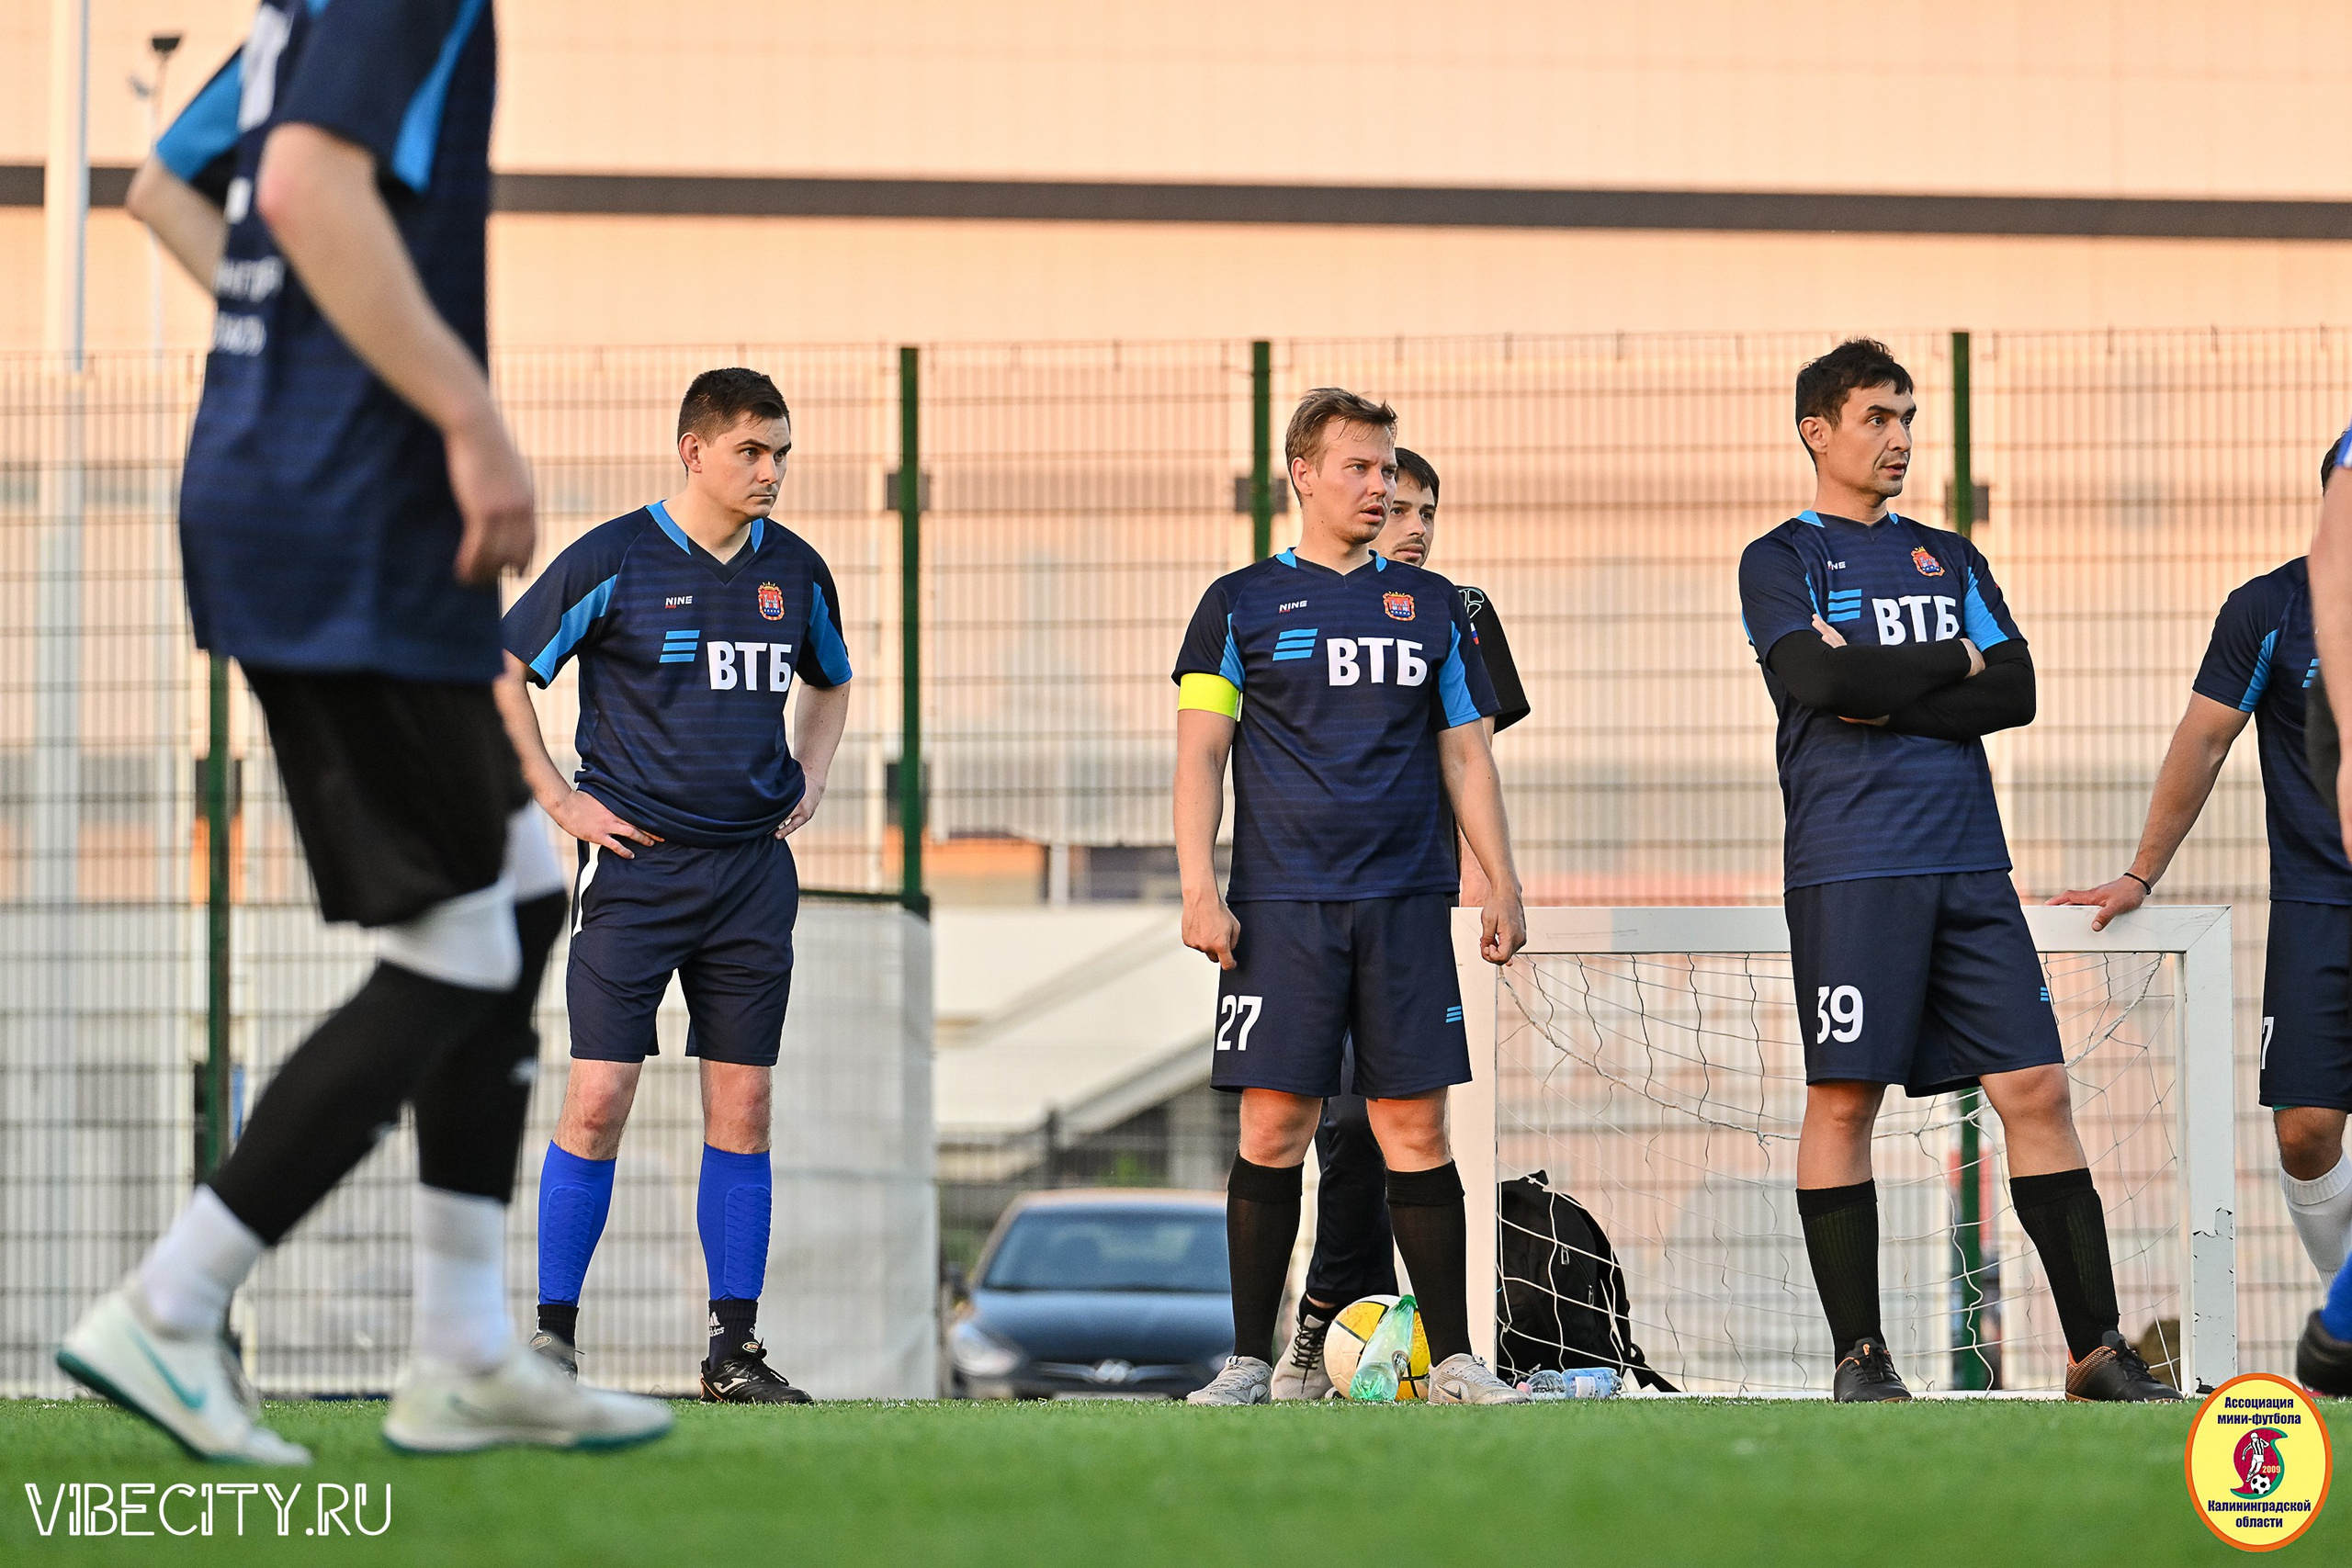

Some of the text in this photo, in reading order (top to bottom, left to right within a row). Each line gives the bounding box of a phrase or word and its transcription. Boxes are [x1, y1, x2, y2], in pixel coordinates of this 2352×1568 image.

[665, 595, 694, 606] NINE
[1279, 600, 1307, 612] NINE
[1871, 595, 1961, 646] ВТБ
[707, 641, 792, 693] ВТБ
[1327, 637, 1428, 687] ВТБ
[1216, 994, 1263, 1051] 27
